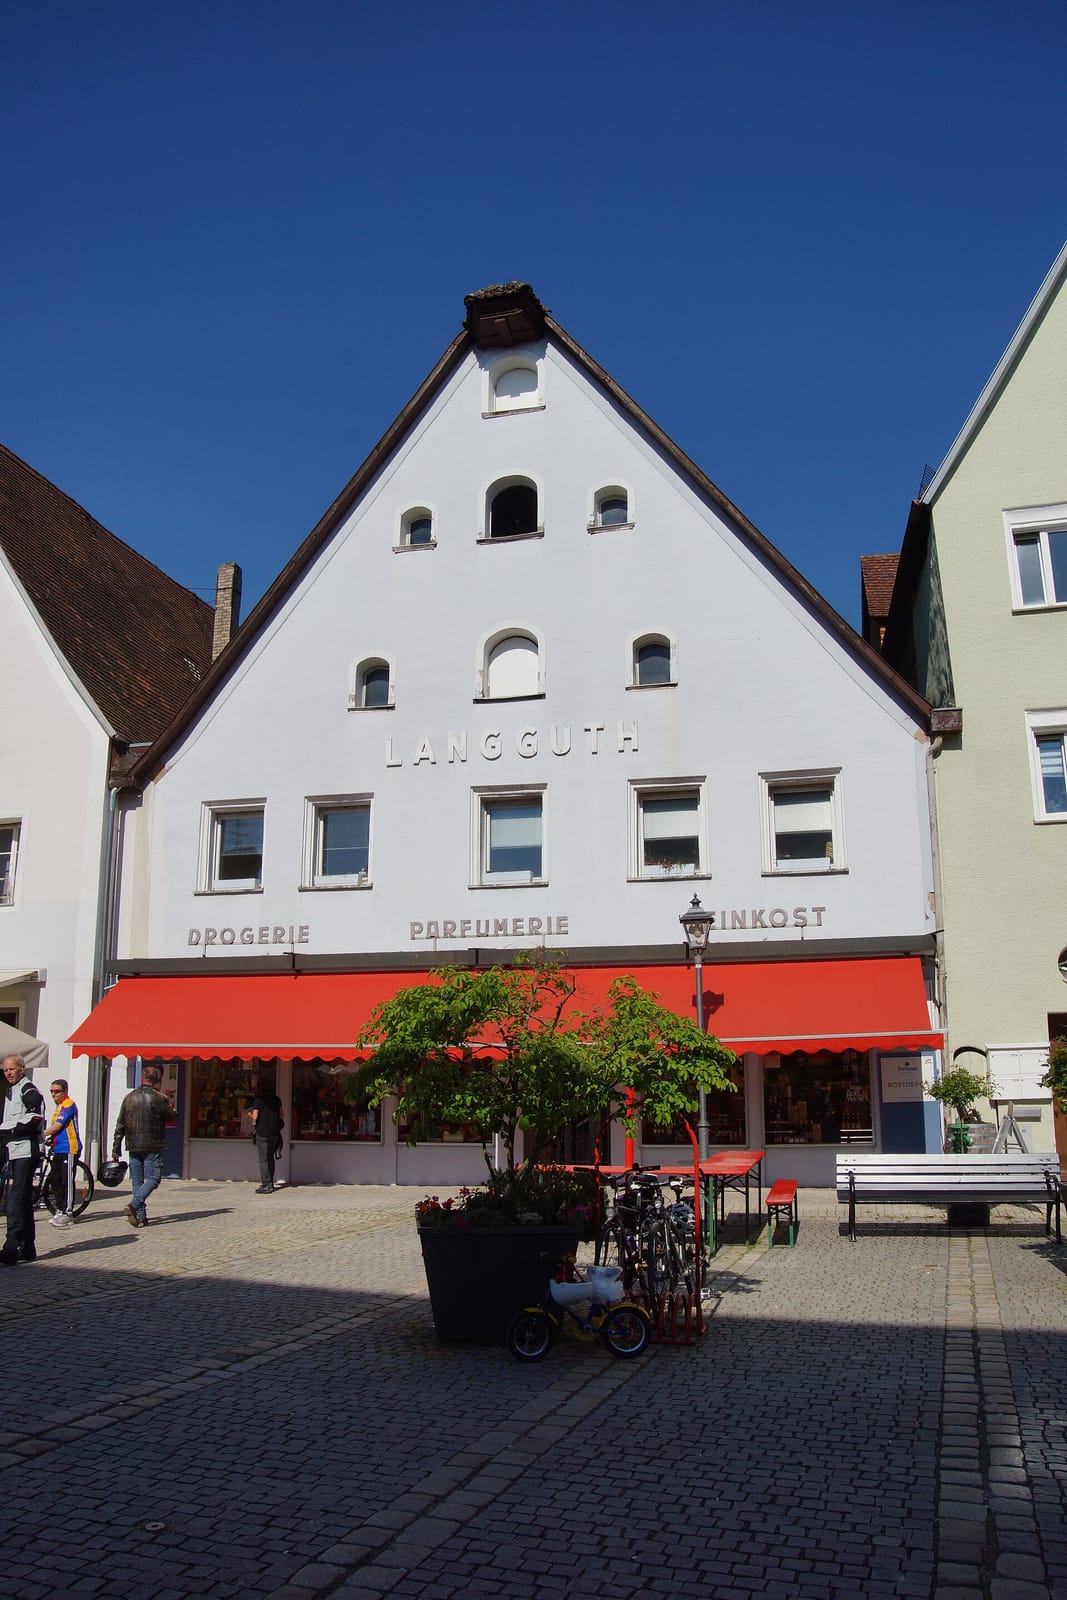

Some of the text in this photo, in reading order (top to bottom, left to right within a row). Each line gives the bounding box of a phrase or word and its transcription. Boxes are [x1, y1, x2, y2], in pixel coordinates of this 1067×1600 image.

[385, 720, 639, 768] LANGGUTH
[187, 925, 310, 946] DROGERIE
[409, 915, 569, 941] PARFUMERIE
